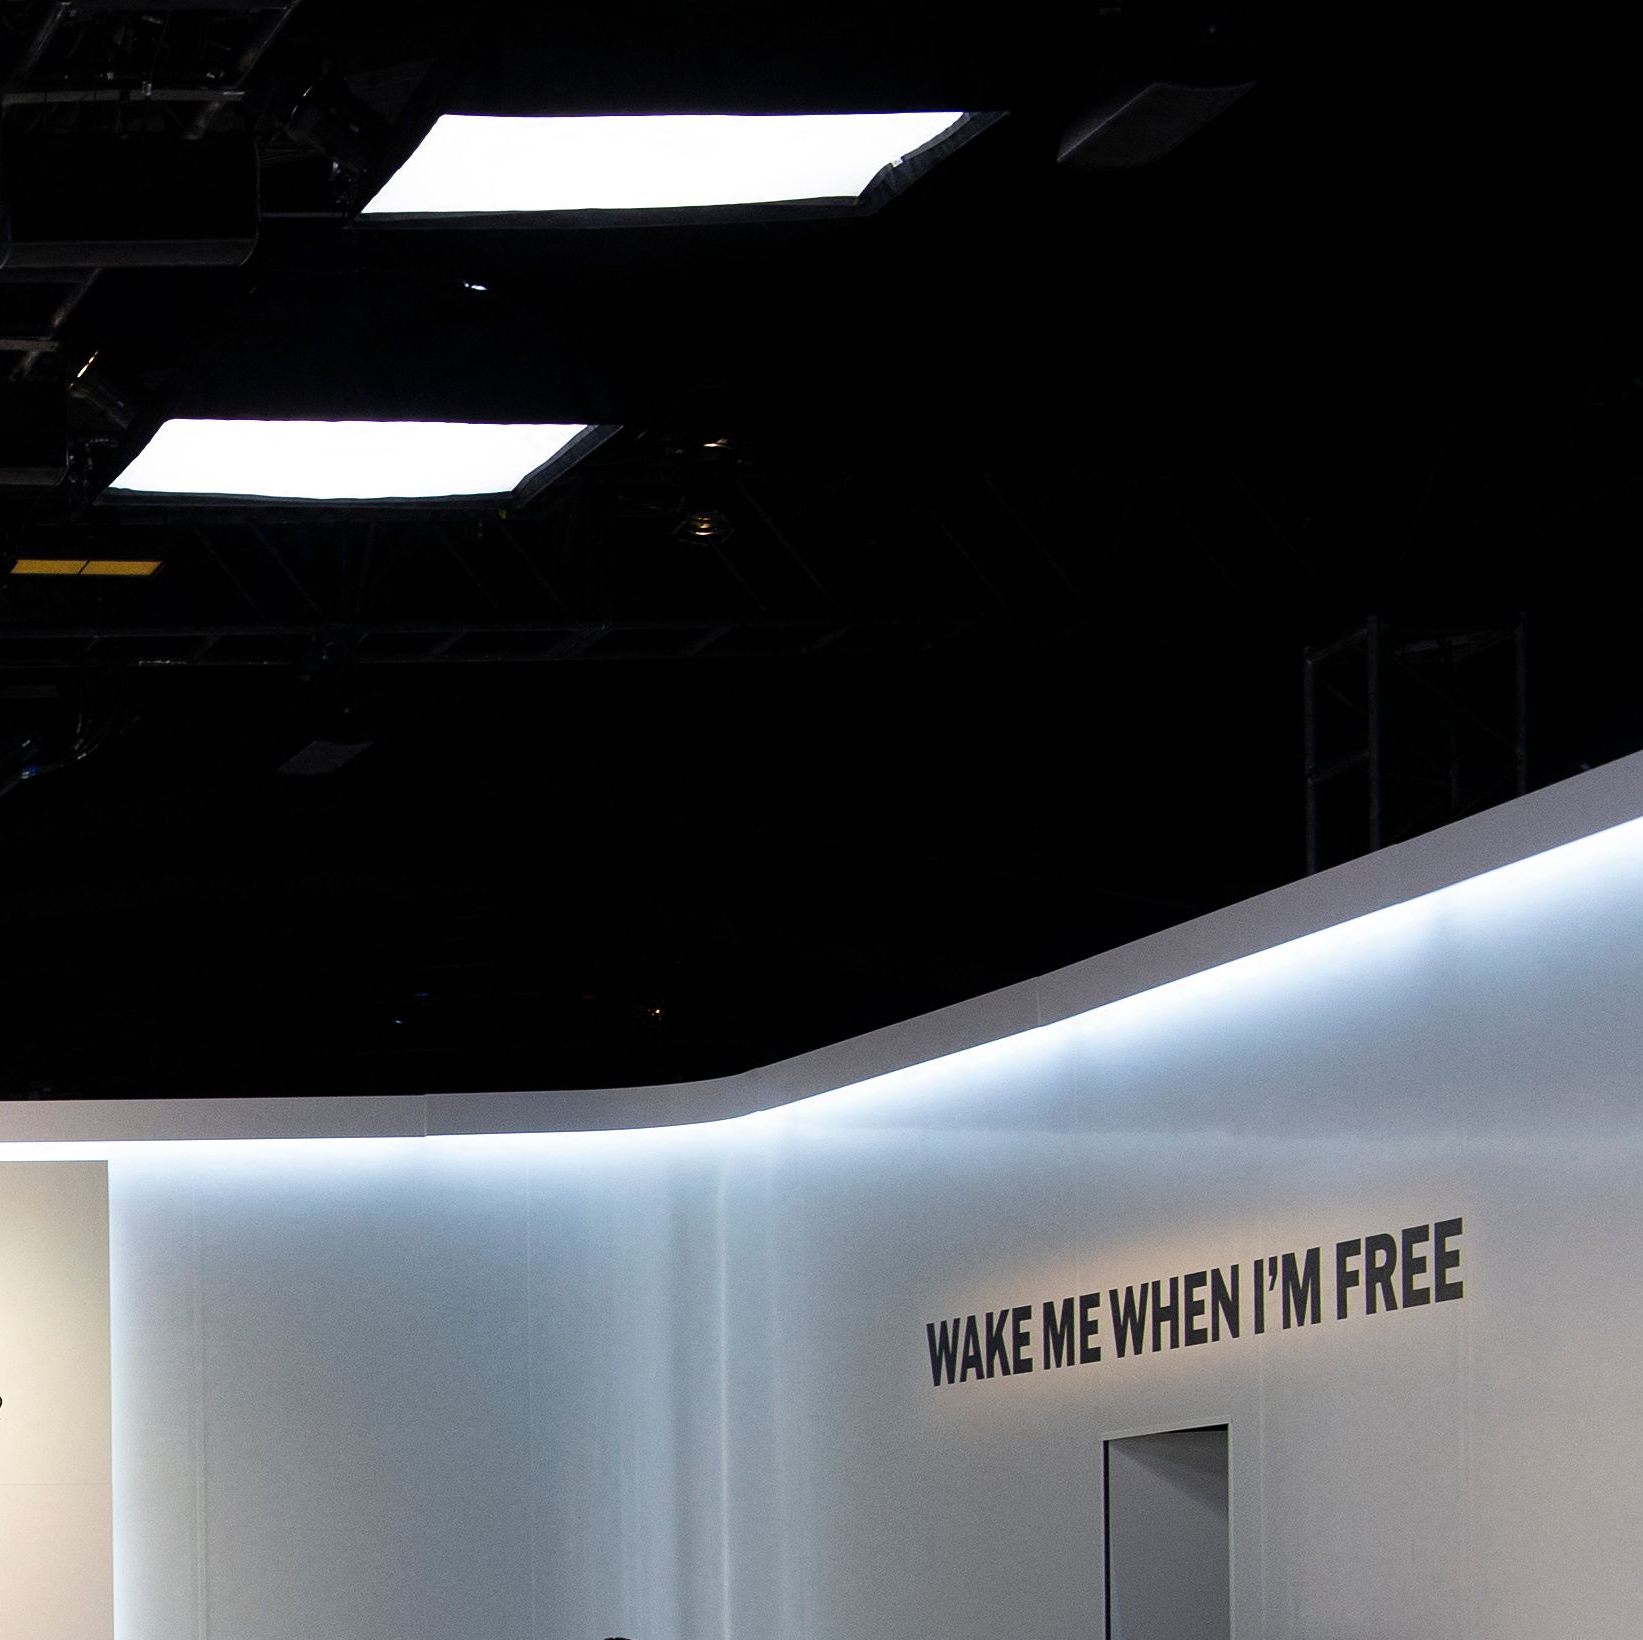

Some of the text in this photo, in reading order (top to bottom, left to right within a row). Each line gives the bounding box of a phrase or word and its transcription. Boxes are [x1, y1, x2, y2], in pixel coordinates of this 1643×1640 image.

[925, 1216, 1465, 1387] WAKE ME WHEN I'M FREE
